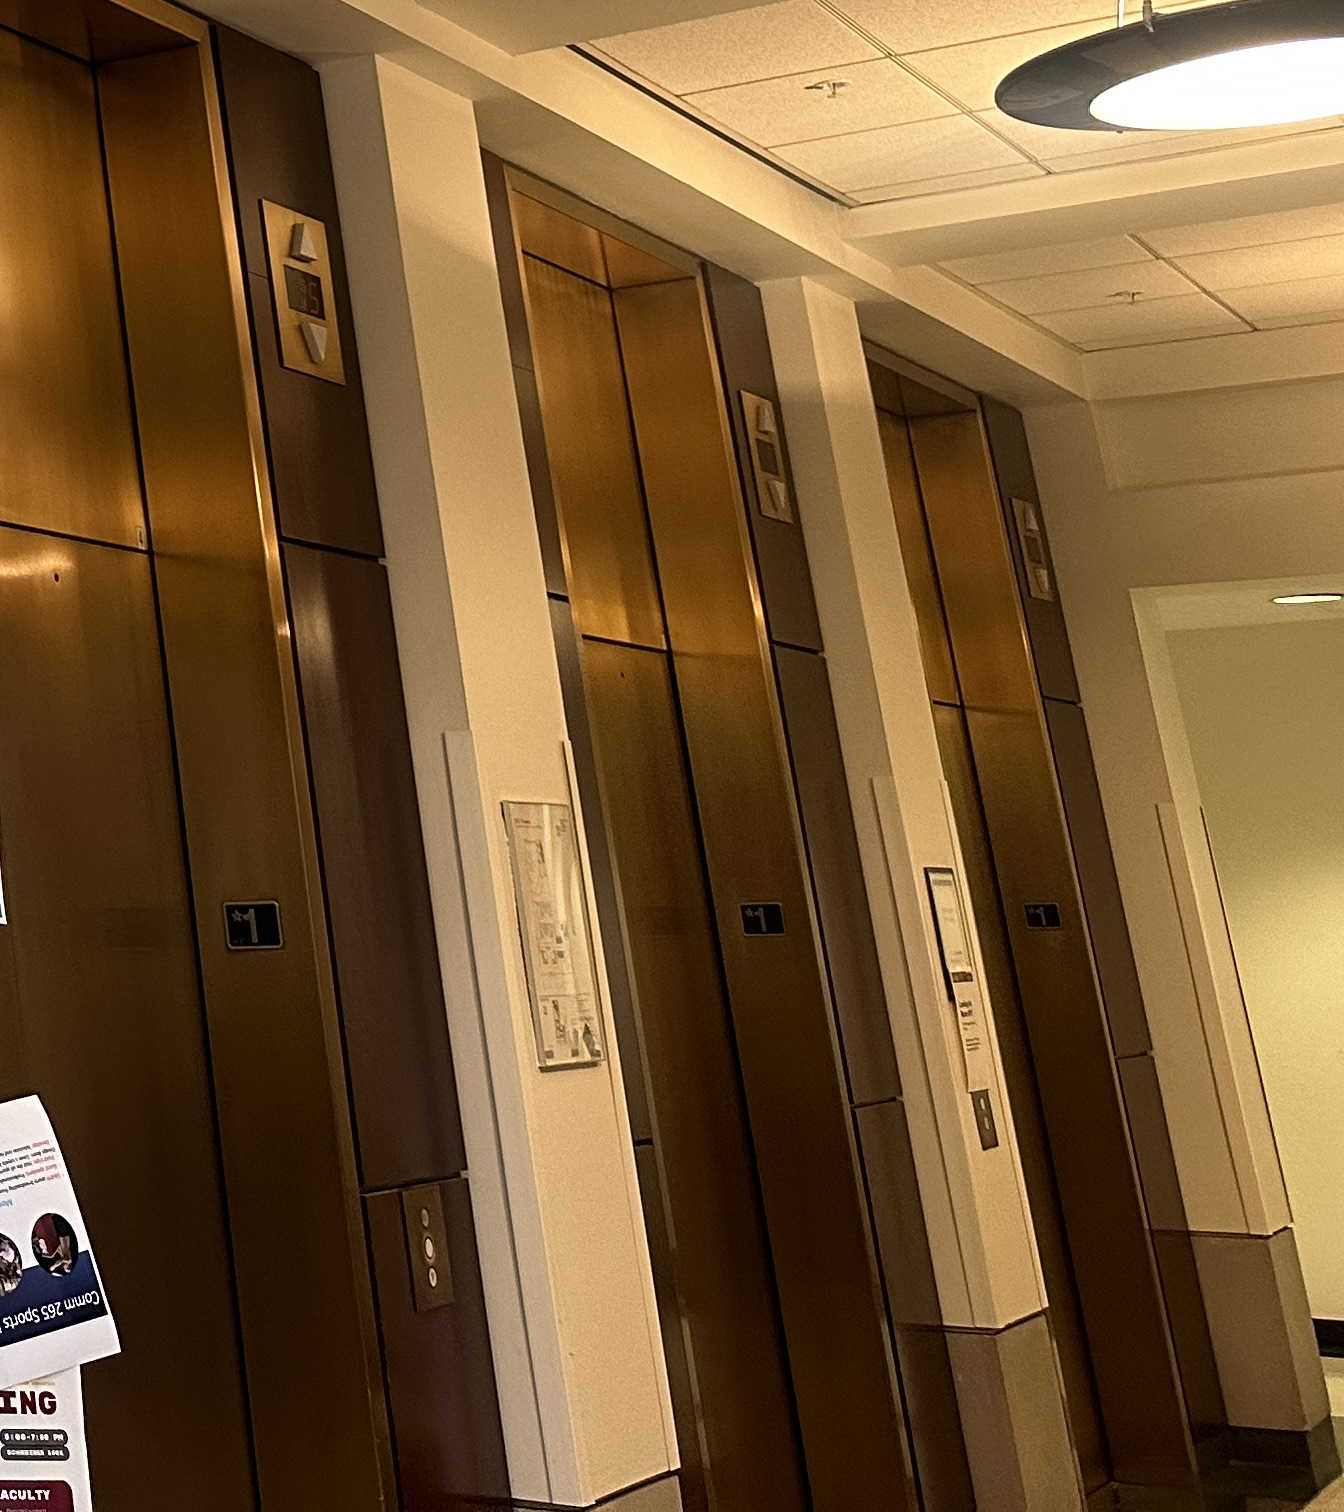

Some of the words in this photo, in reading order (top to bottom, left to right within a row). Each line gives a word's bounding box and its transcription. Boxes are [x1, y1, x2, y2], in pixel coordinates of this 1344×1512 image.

[242, 909, 259, 943] 1
[753, 908, 768, 932] 1
[1036, 907, 1050, 925] 1
[64, 1290, 100, 1310] Comm
[3, 1308, 41, 1329] Sports
[41, 1303, 63, 1321] 265
